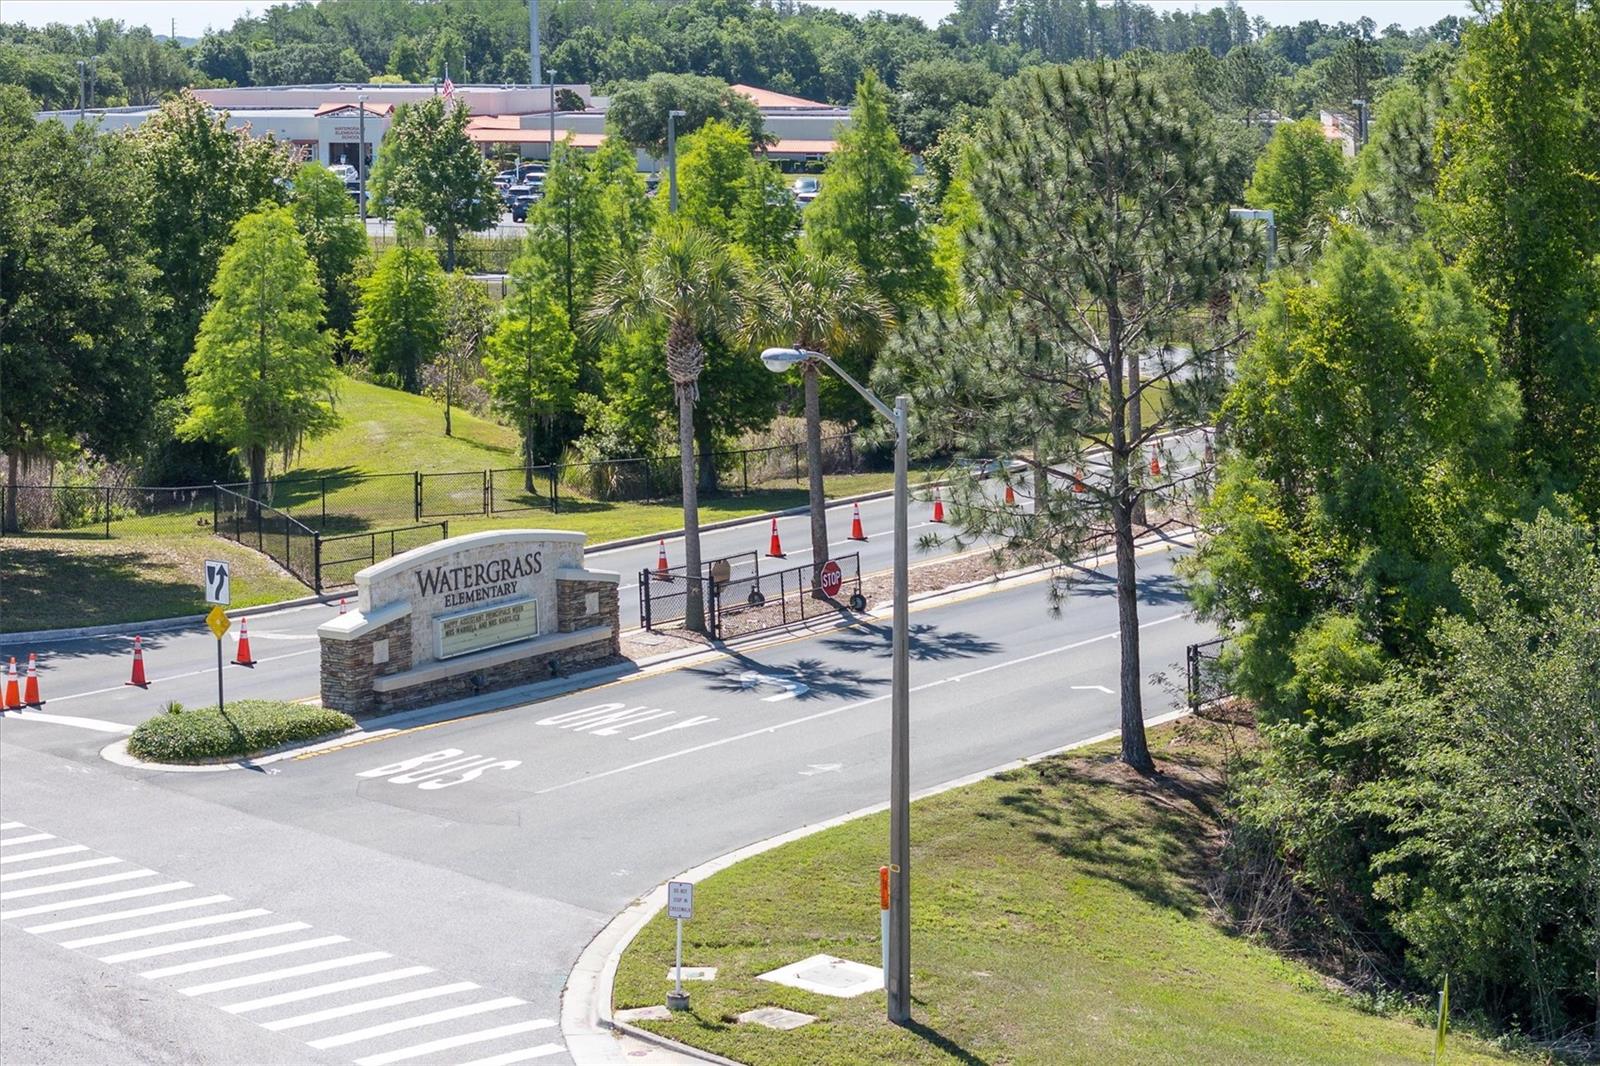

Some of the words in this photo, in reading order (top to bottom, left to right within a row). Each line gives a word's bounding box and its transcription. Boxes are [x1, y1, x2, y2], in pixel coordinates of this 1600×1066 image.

[416, 551, 542, 597] WATERGRASS
[823, 571, 840, 587] STOP
[445, 581, 518, 607] ELEMENTARY
[536, 702, 720, 741] ONLY
[355, 748, 523, 790] BUS
